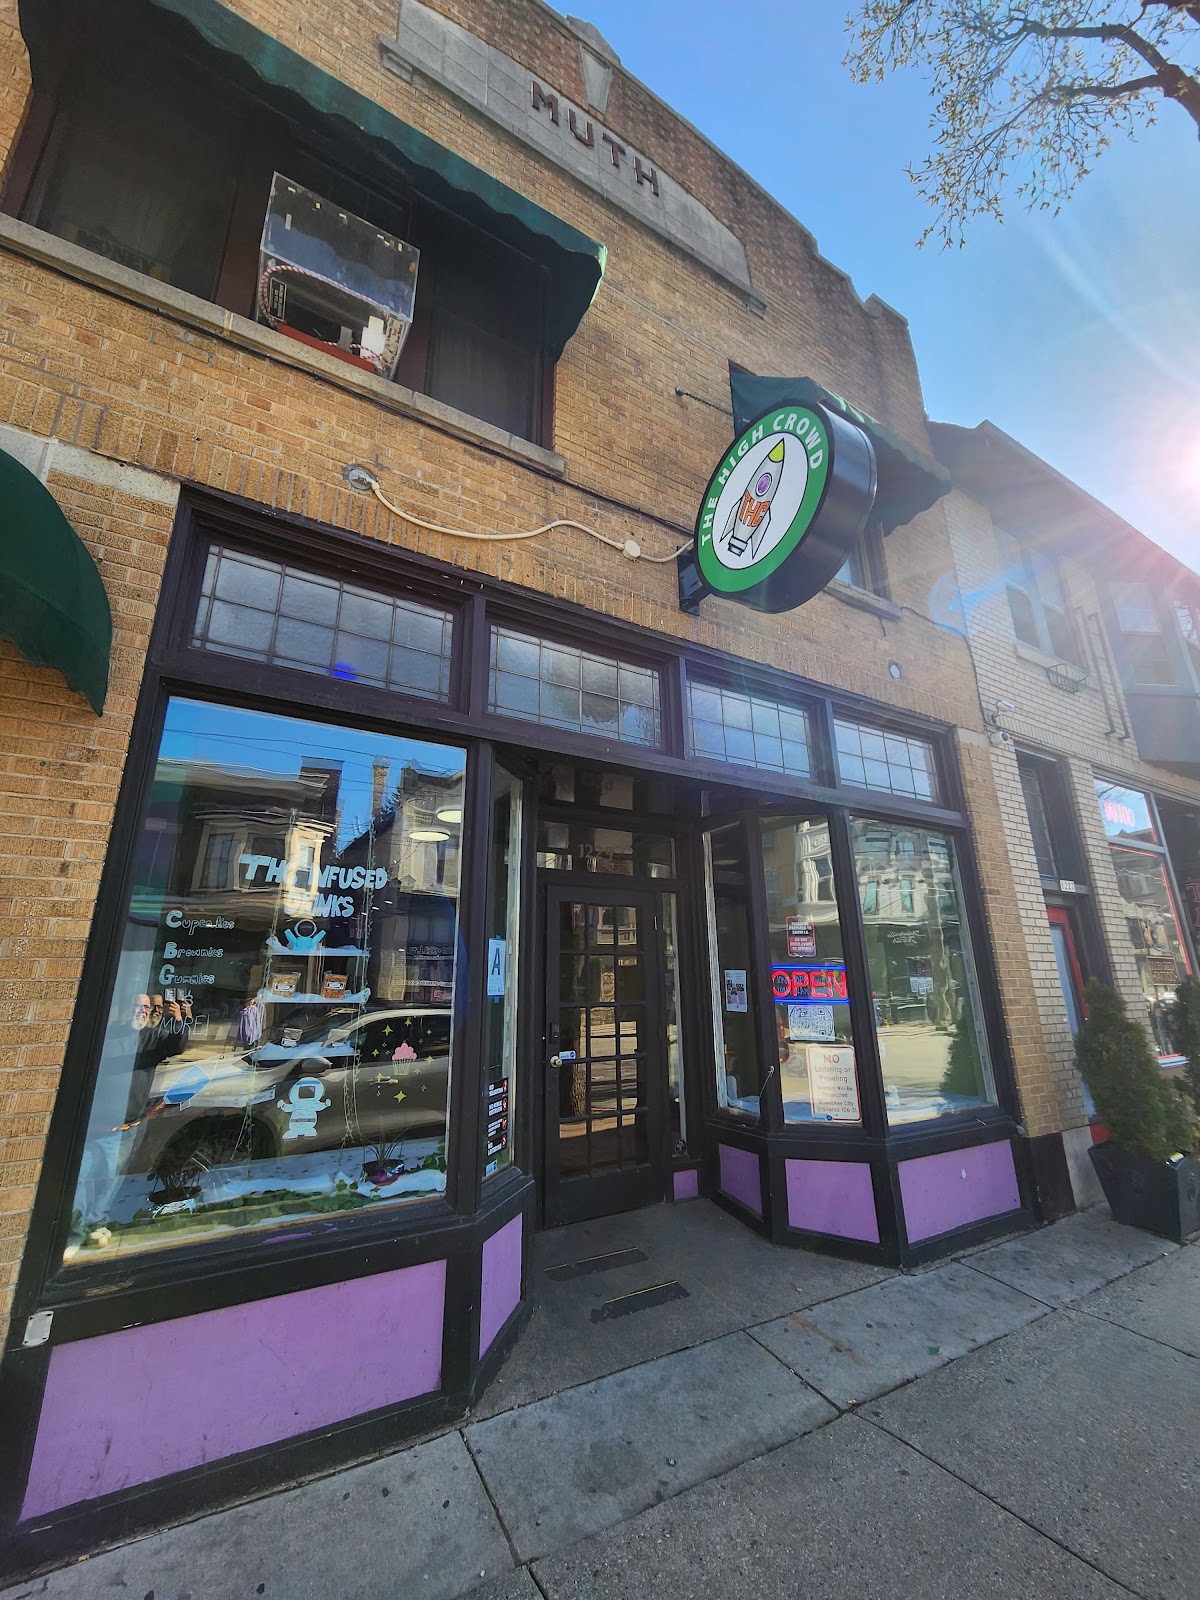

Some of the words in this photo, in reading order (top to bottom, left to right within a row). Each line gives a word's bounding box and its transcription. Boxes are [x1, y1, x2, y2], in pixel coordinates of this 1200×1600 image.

[531, 80, 660, 197] MUTH
[701, 496, 719, 546] THE
[717, 424, 764, 486] HIGH
[773, 413, 823, 469] CROWD
[739, 490, 770, 527] THC
[578, 843, 614, 860] 1229
[284, 892, 355, 918] INKS
[165, 910, 235, 935] Cupcakes
[163, 941, 224, 958] Brownies
[491, 947, 501, 976] A
[158, 964, 215, 985] Gummies
[772, 970, 848, 998] OPEN
[158, 1013, 210, 1037] MORE!
[815, 1065, 842, 1075] Loitering
[823, 1054, 840, 1064] NO
[819, 1074, 848, 1083] Prowling
